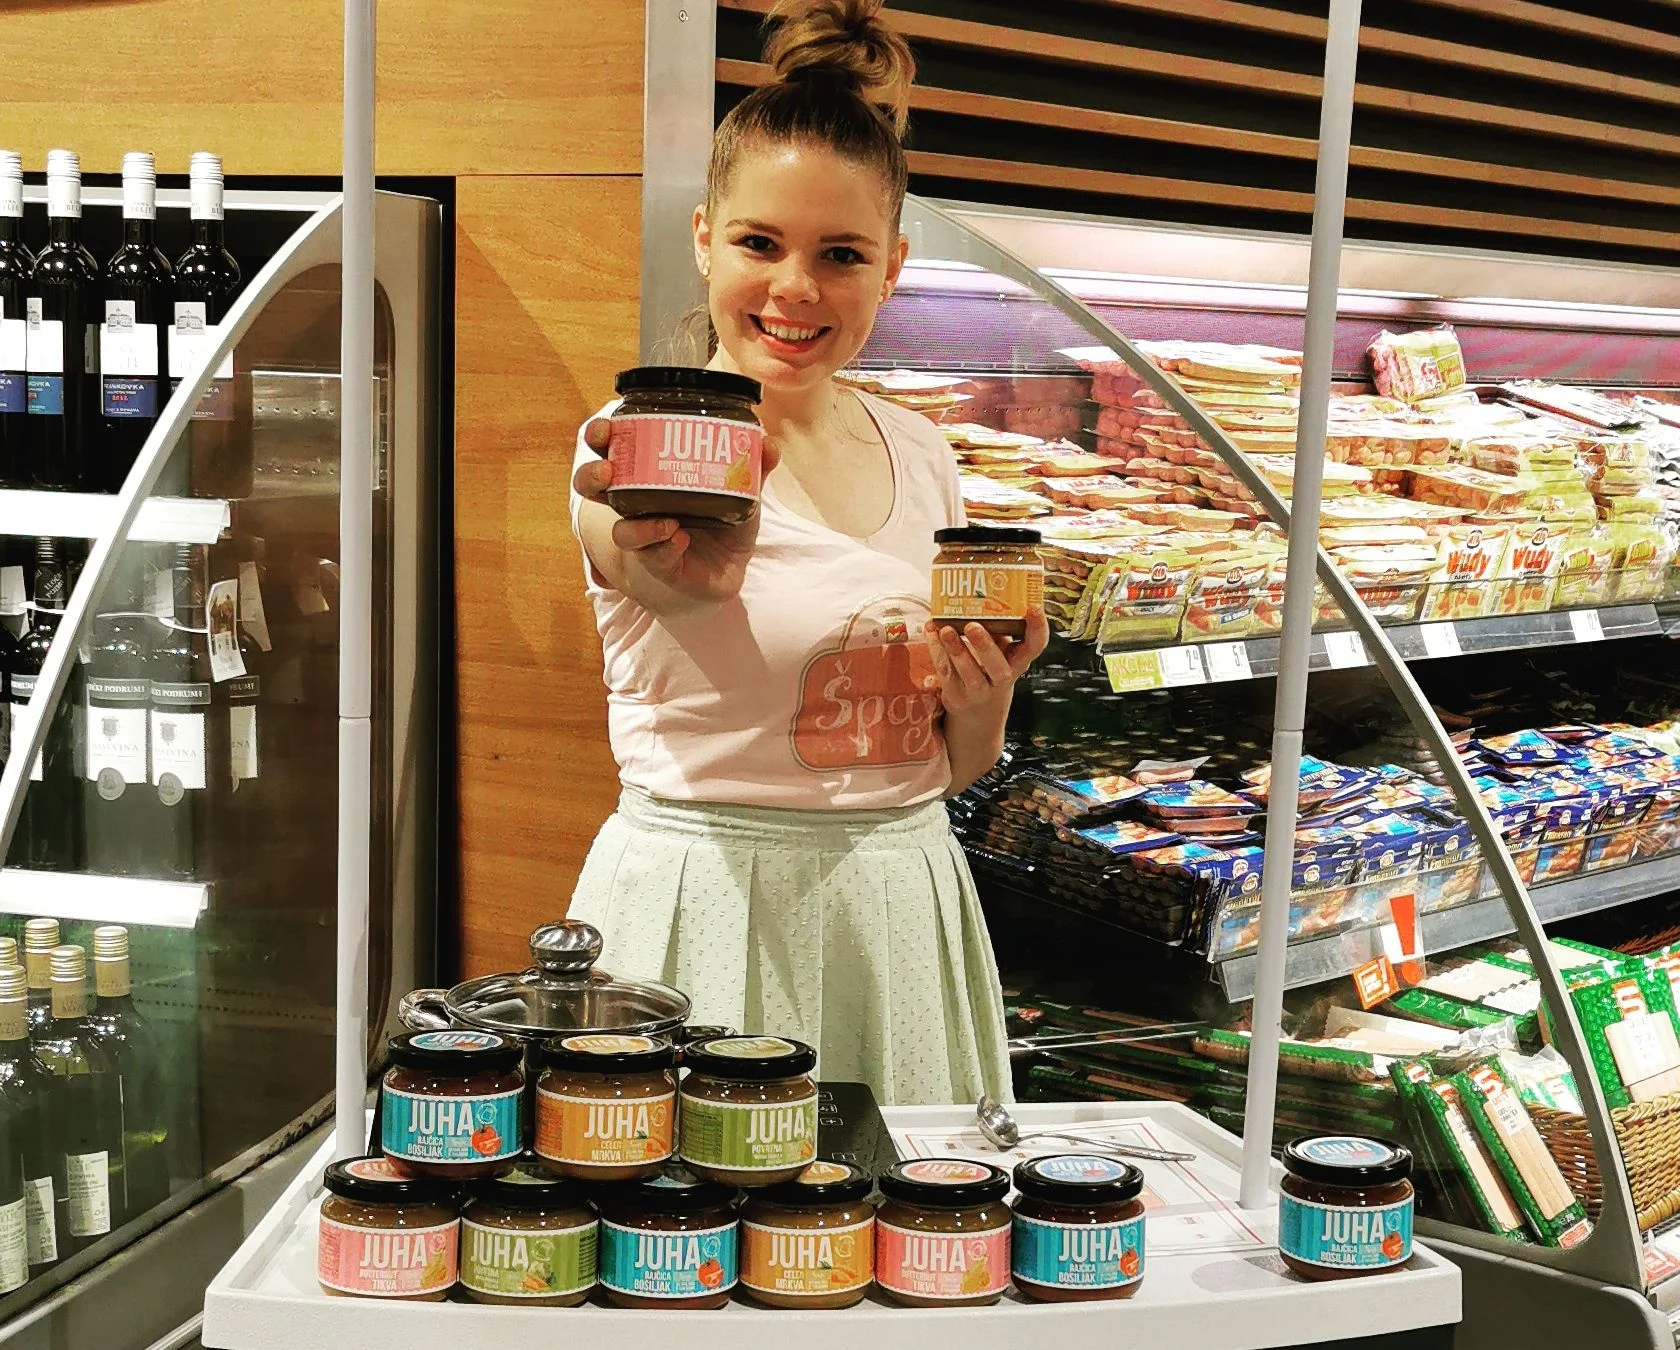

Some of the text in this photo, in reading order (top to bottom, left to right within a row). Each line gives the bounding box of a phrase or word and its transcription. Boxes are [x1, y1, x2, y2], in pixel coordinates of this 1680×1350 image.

[659, 422, 732, 464] JUHA
[658, 460, 701, 473] BUTTERNUT
[673, 472, 700, 485] TIKVA
[1512, 544, 1554, 575] Wudy
[940, 569, 987, 598] JUHA
[408, 1099, 475, 1136] JUHA
[584, 1104, 649, 1139] JUHA
[746, 1106, 806, 1144] JUHA
[407, 1143, 444, 1157] BOSILJAK
[591, 1149, 622, 1161] MRKVA
[1321, 1210, 1385, 1244] JUHA
[360, 1234, 427, 1269] JUHA
[471, 1230, 530, 1271] JUHA
[635, 1236, 701, 1271] JUHA
[768, 1234, 834, 1270] JUHA
[901, 1236, 967, 1273] JUHA
[1059, 1228, 1123, 1263] JUHA
[372, 1280, 397, 1291] TIKVA
[634, 1279, 671, 1292] BOSILJAK
[913, 1280, 937, 1293] TIKVA
